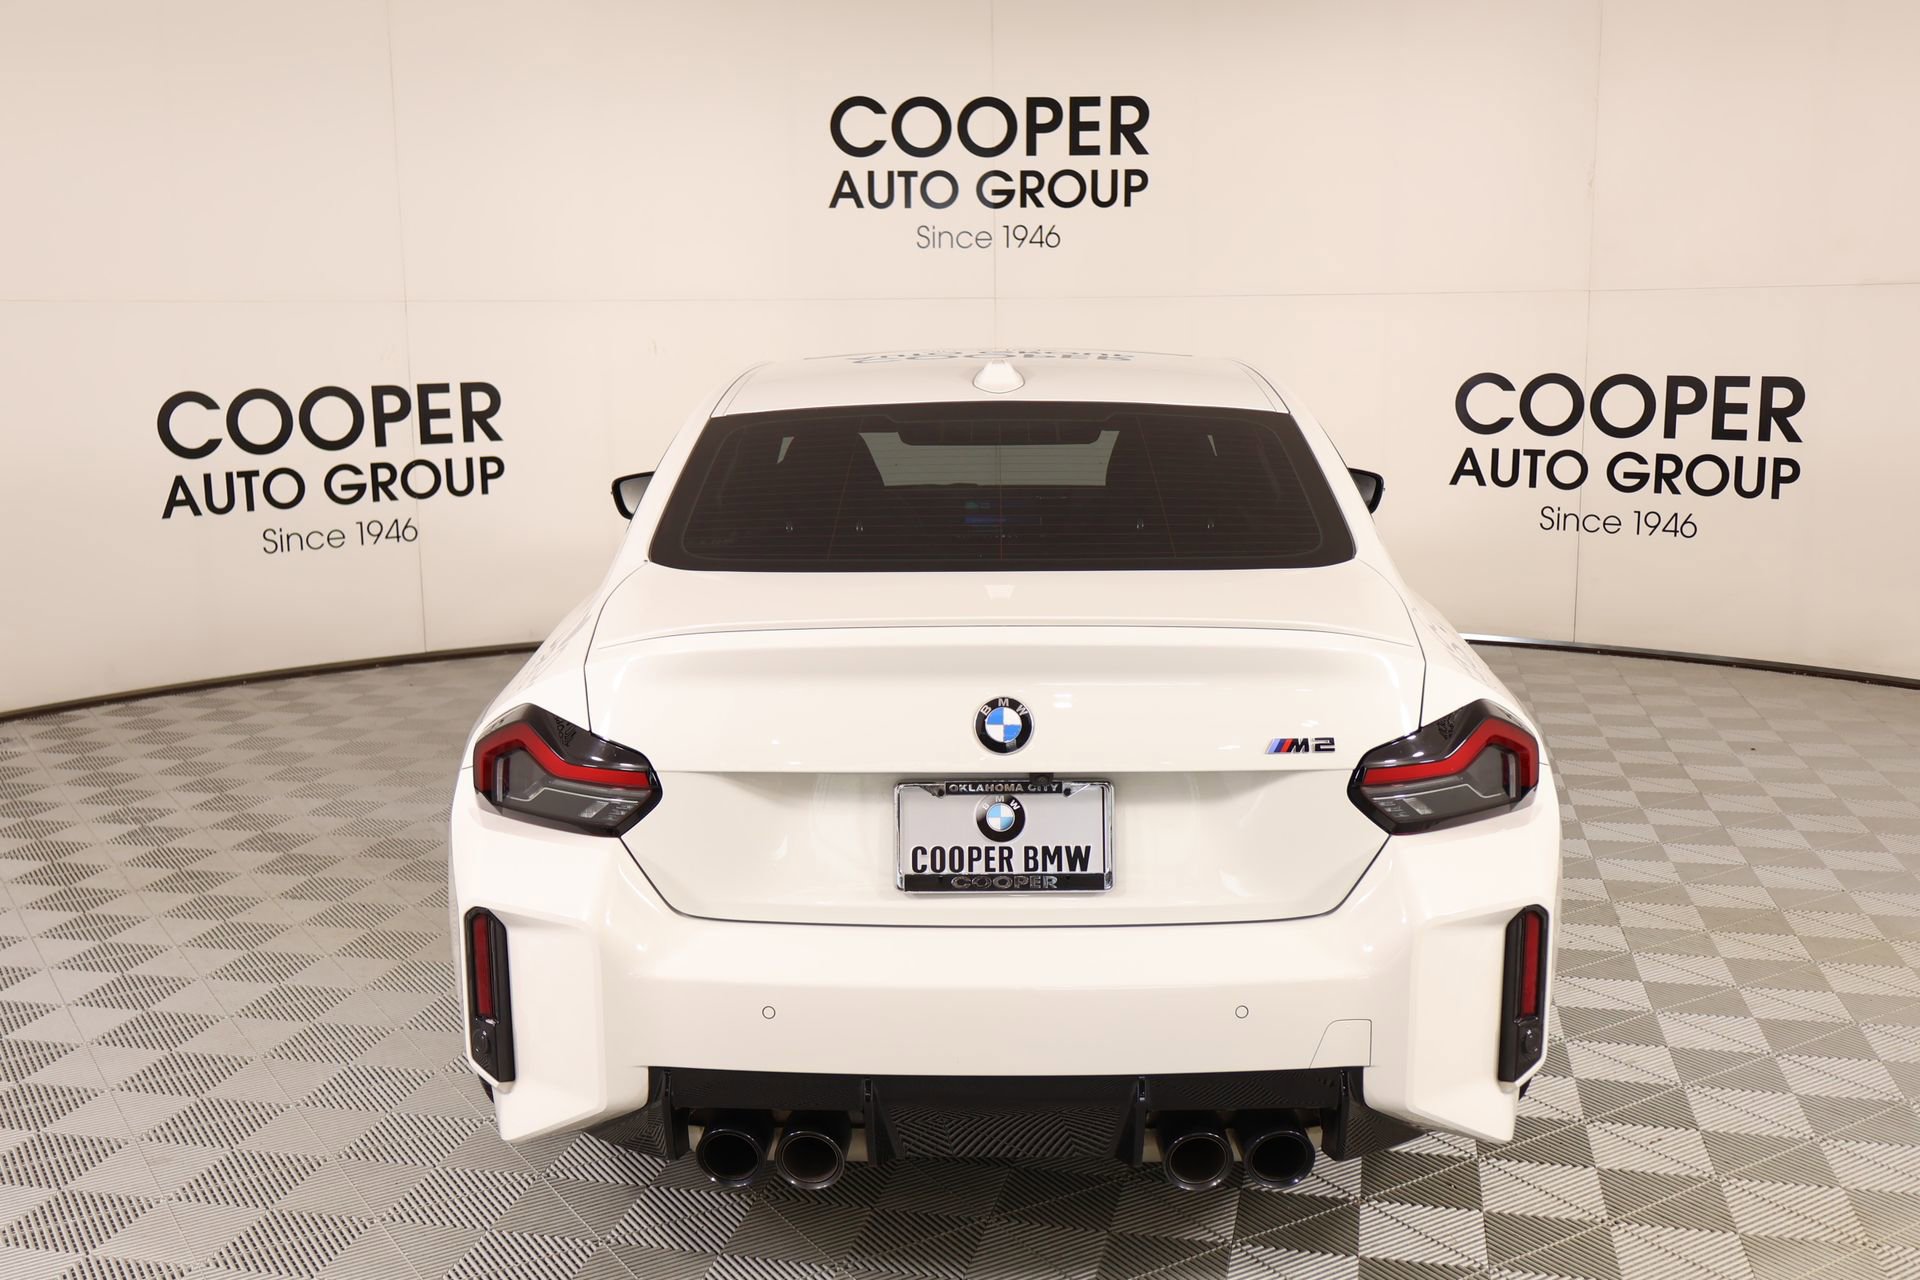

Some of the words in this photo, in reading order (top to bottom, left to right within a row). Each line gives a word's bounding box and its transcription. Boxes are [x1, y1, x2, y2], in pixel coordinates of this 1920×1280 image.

[830, 95, 1150, 158] COOPER
[829, 169, 959, 209] AUTO
[976, 168, 1149, 209] GROUP
[916, 225, 993, 249] Since
[1002, 224, 1061, 248] 1946
[157, 381, 503, 459] COOPER
[1455, 372, 1806, 443] COOPER
[162, 466, 305, 519] AUTO
[324, 455, 505, 505] GROUP
[1449, 447, 1588, 490] AUTO
[1607, 451, 1801, 500] GROUP
[262, 528, 346, 554] Since
[355, 517, 419, 546] 1946
[1539, 505, 1622, 534] Since
[1633, 510, 1698, 539] 1946
[980, 698, 1028, 716] BMW
[948, 783, 1024, 792] OKLAHOMA
[1027, 783, 1060, 792] CITY
[982, 795, 1021, 810] BMW
[911, 845, 1014, 874] COOPER
[1023, 845, 1092, 873] BMW
[950, 875, 1058, 889] COOPER
